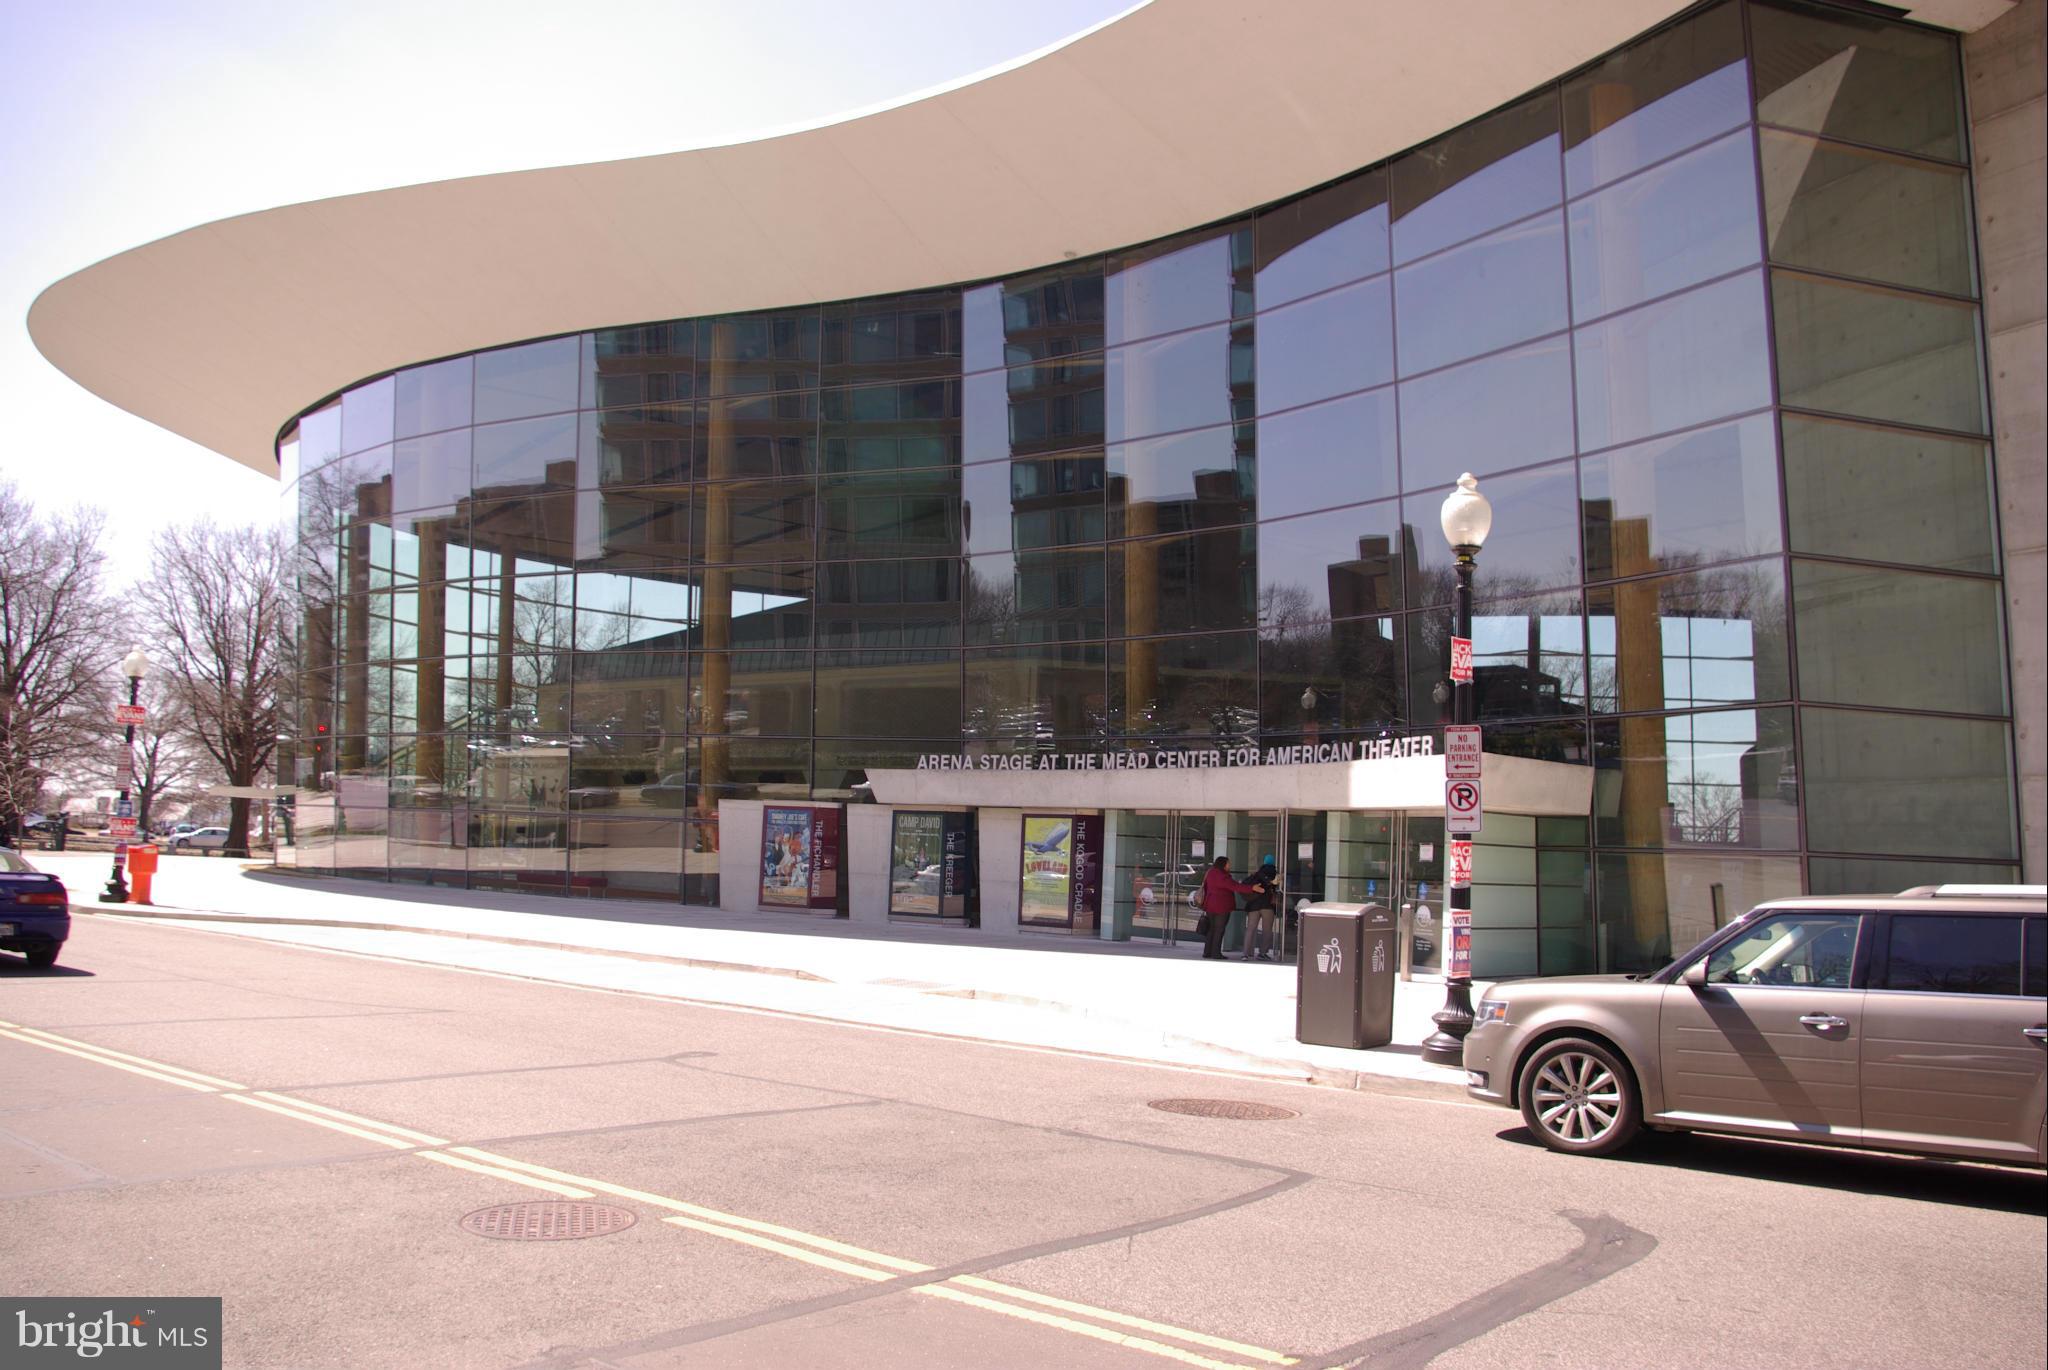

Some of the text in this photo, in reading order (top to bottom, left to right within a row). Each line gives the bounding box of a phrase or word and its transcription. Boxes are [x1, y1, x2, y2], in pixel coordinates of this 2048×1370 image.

[1457, 734, 1468, 743] NO
[917, 735, 1434, 770] ARENA STAGE AT THE MEAD CENTER FOR AMERICAN THEATER
[1449, 743, 1477, 753] PARKING
[1447, 753, 1479, 763] ENTRANCE
[899, 816, 940, 829] CAMP DAVID
[811, 821, 823, 896] THE FICHANDLER
[944, 832, 955, 898] THE KREEGER
[1073, 820, 1086, 923] THE KOGOD CRADLE
[1453, 916, 1470, 925] VOTE
[1455, 950, 1468, 960] FOR
